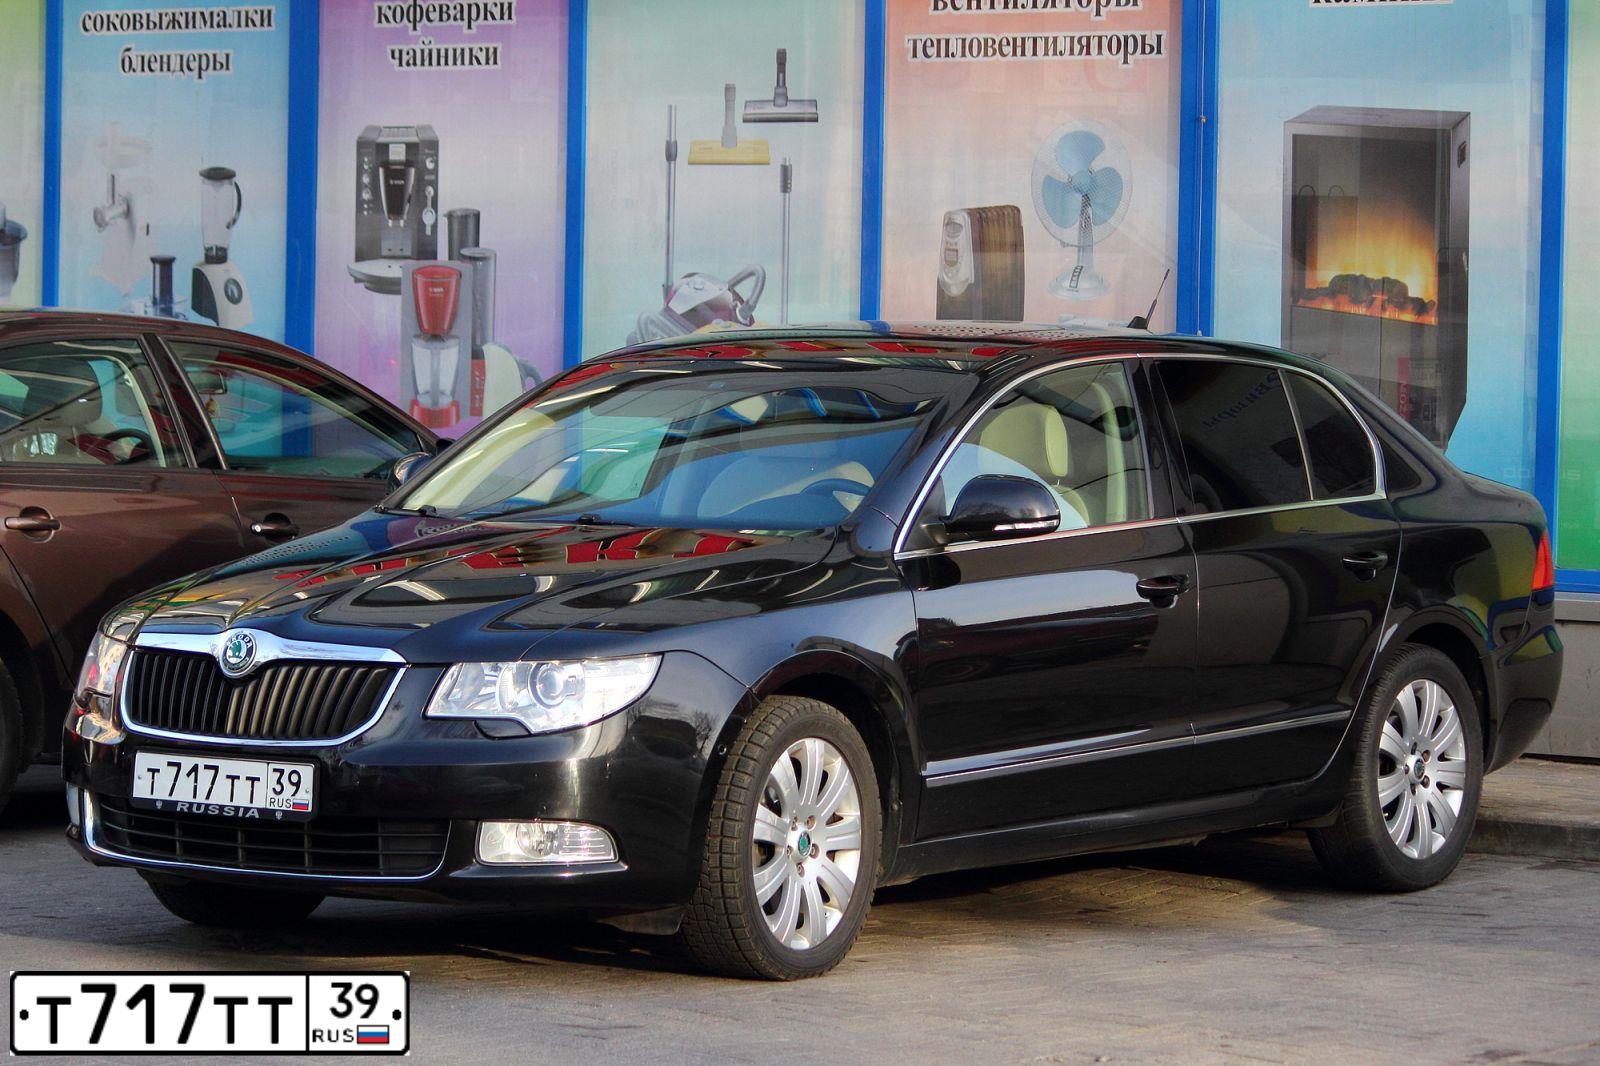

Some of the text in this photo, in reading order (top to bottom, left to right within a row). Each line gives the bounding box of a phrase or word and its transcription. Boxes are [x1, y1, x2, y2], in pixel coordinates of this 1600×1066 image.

[81, 8, 273, 33] соковыжималки
[376, 0, 514, 31] кофеварки
[390, 40, 499, 67] чайники
[907, 33, 1163, 65] тепловентиляторы
[121, 47, 231, 80] блендеры
[271, 767, 302, 797] 39
[176, 801, 260, 819] RUSSIA
[269, 796, 292, 808] RUS
